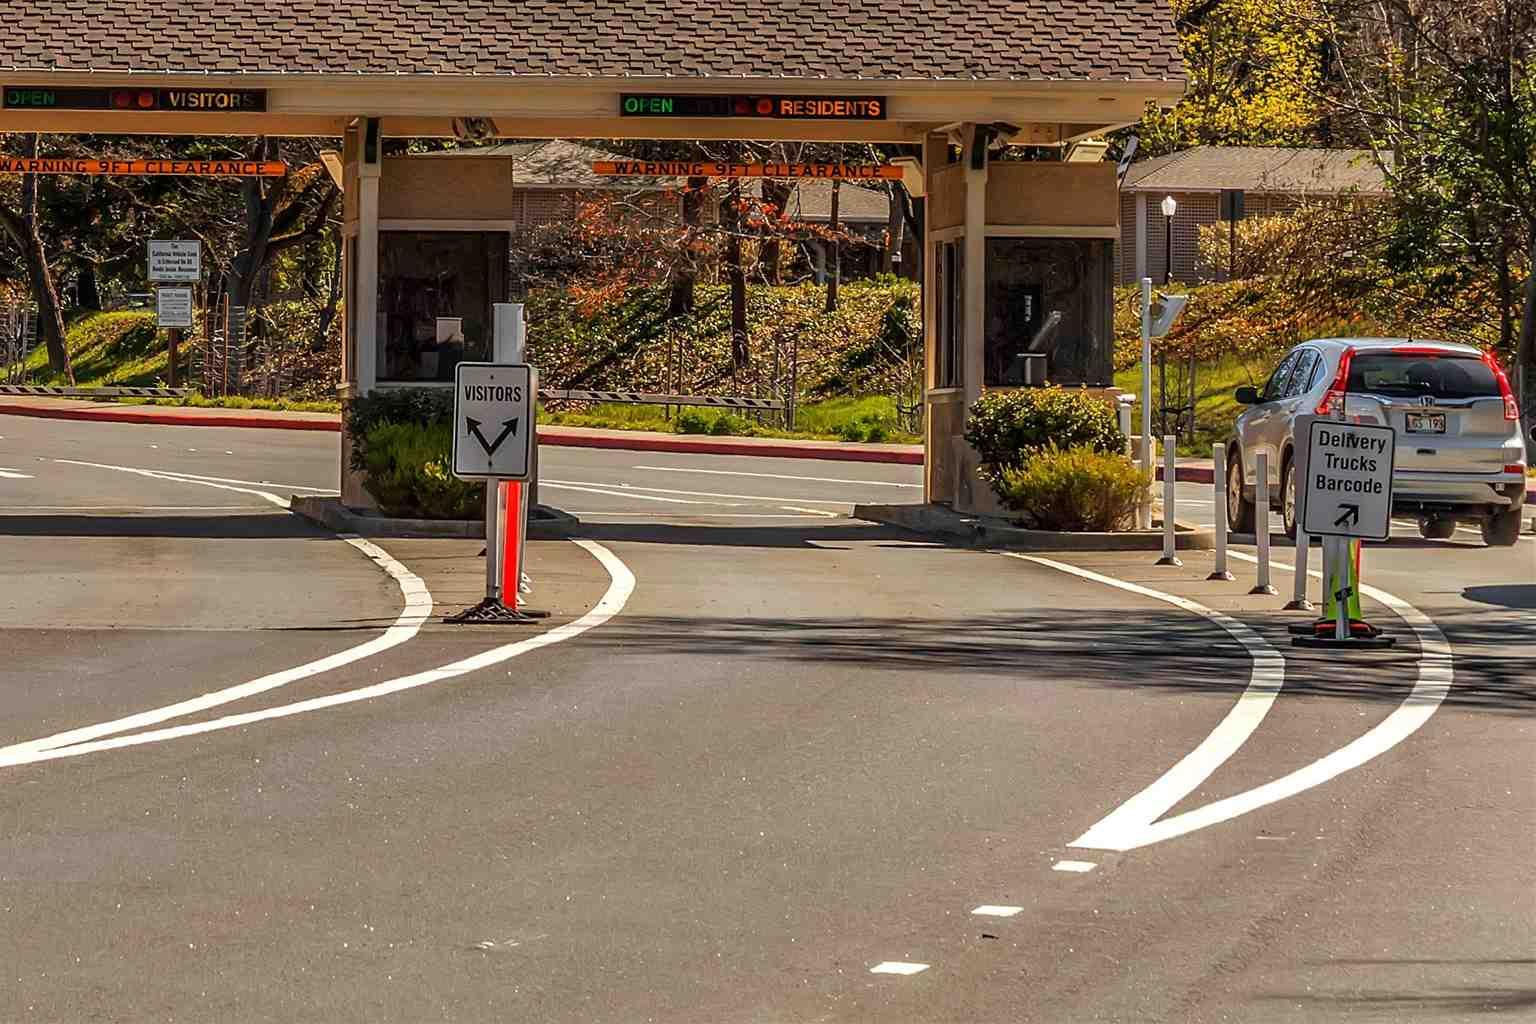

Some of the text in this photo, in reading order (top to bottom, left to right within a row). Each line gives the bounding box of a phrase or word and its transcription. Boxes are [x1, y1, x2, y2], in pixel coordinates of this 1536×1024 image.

[8, 91, 55, 106] OPEN
[169, 91, 259, 108] VISITORS
[624, 97, 673, 113] OPEN
[780, 99, 881, 116] RESIDENTS
[99, 161, 134, 174] 9FT
[145, 161, 266, 175] CLEARANCE
[615, 162, 882, 177] WARNING 9FT CLEARANCE
[464, 384, 522, 402] VISITORS
[1319, 430, 1386, 454] Delivery
[1324, 452, 1377, 472] Trucks
[1316, 474, 1383, 494] Barcode
